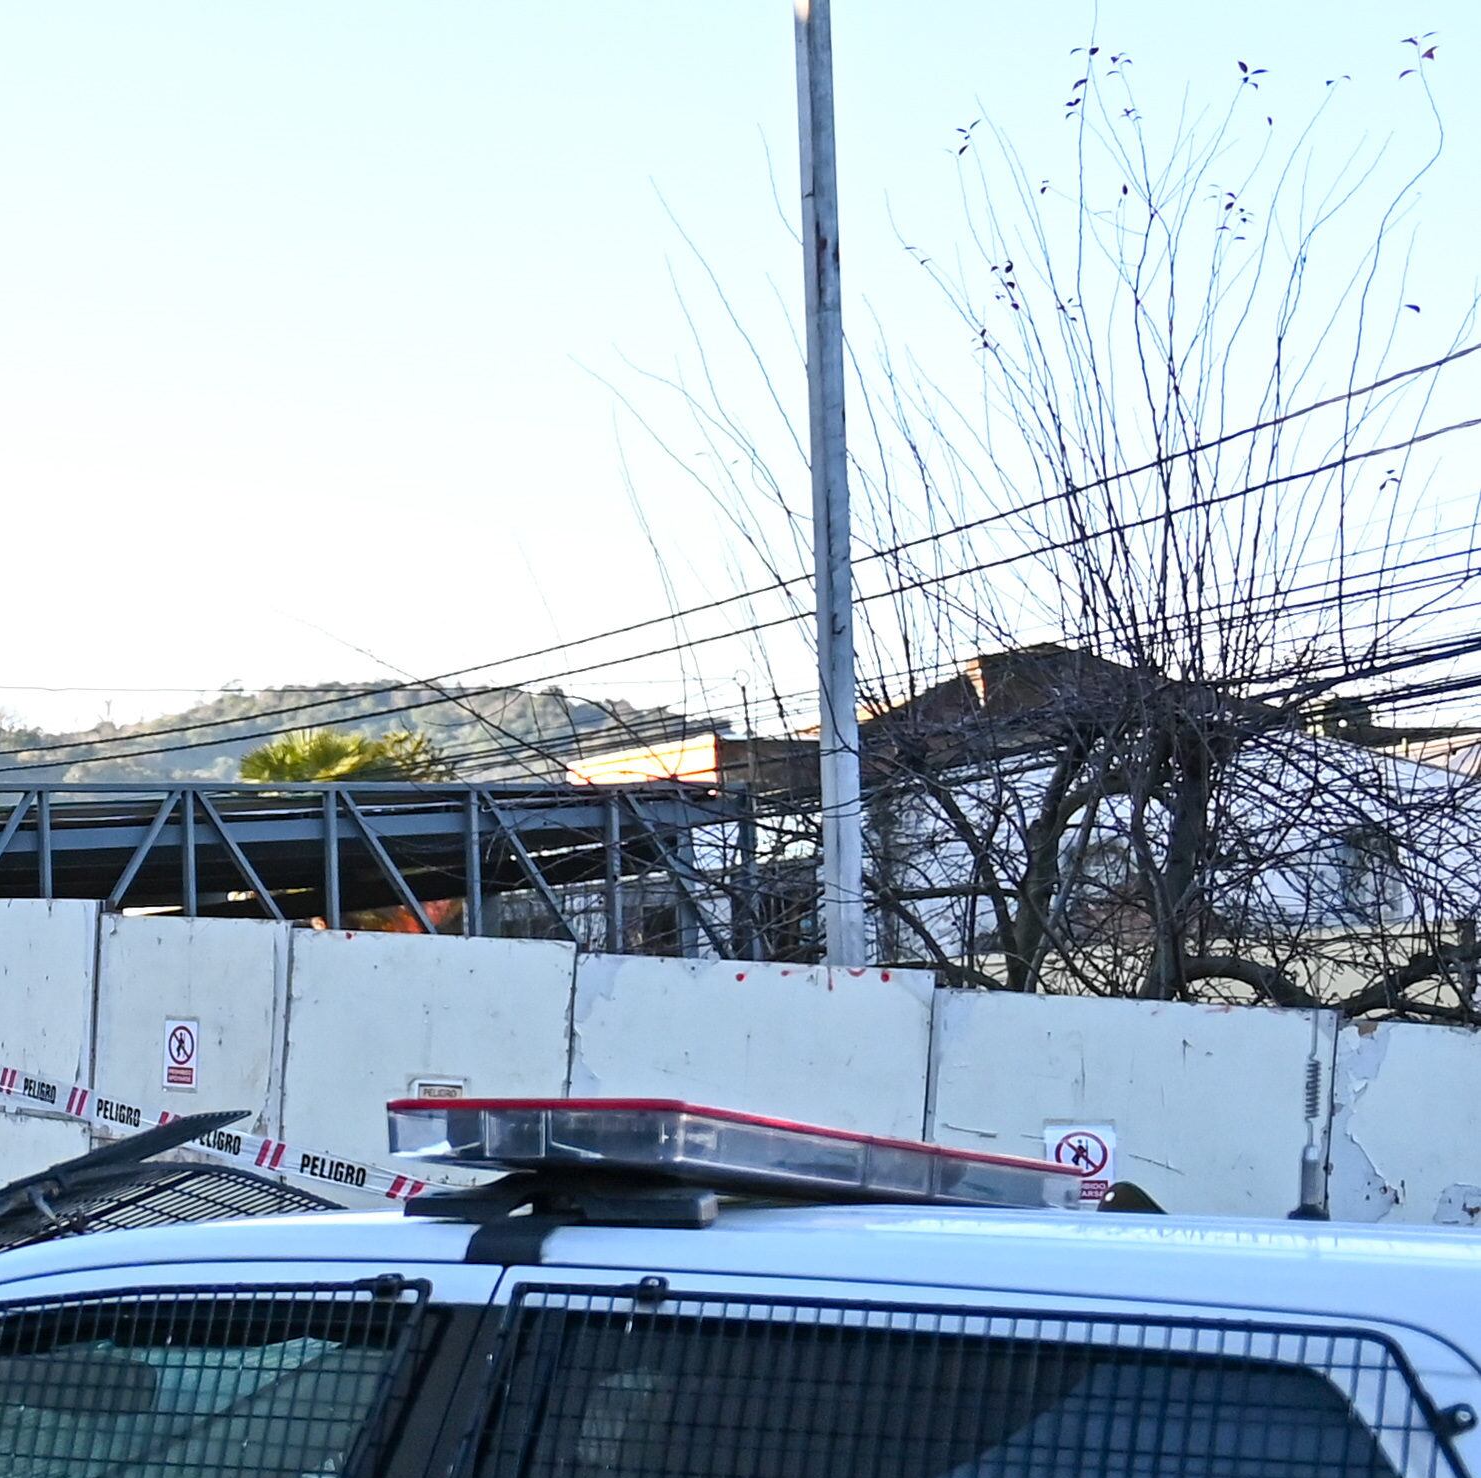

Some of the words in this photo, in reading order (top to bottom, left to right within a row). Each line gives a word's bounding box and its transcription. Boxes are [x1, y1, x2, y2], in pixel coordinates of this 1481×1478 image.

[23, 1077, 57, 1104] PELIGRO
[423, 1088, 457, 1097] PELIGRO
[96, 1099, 141, 1127] PELIGRO
[300, 1154, 366, 1187] PELIGRO
